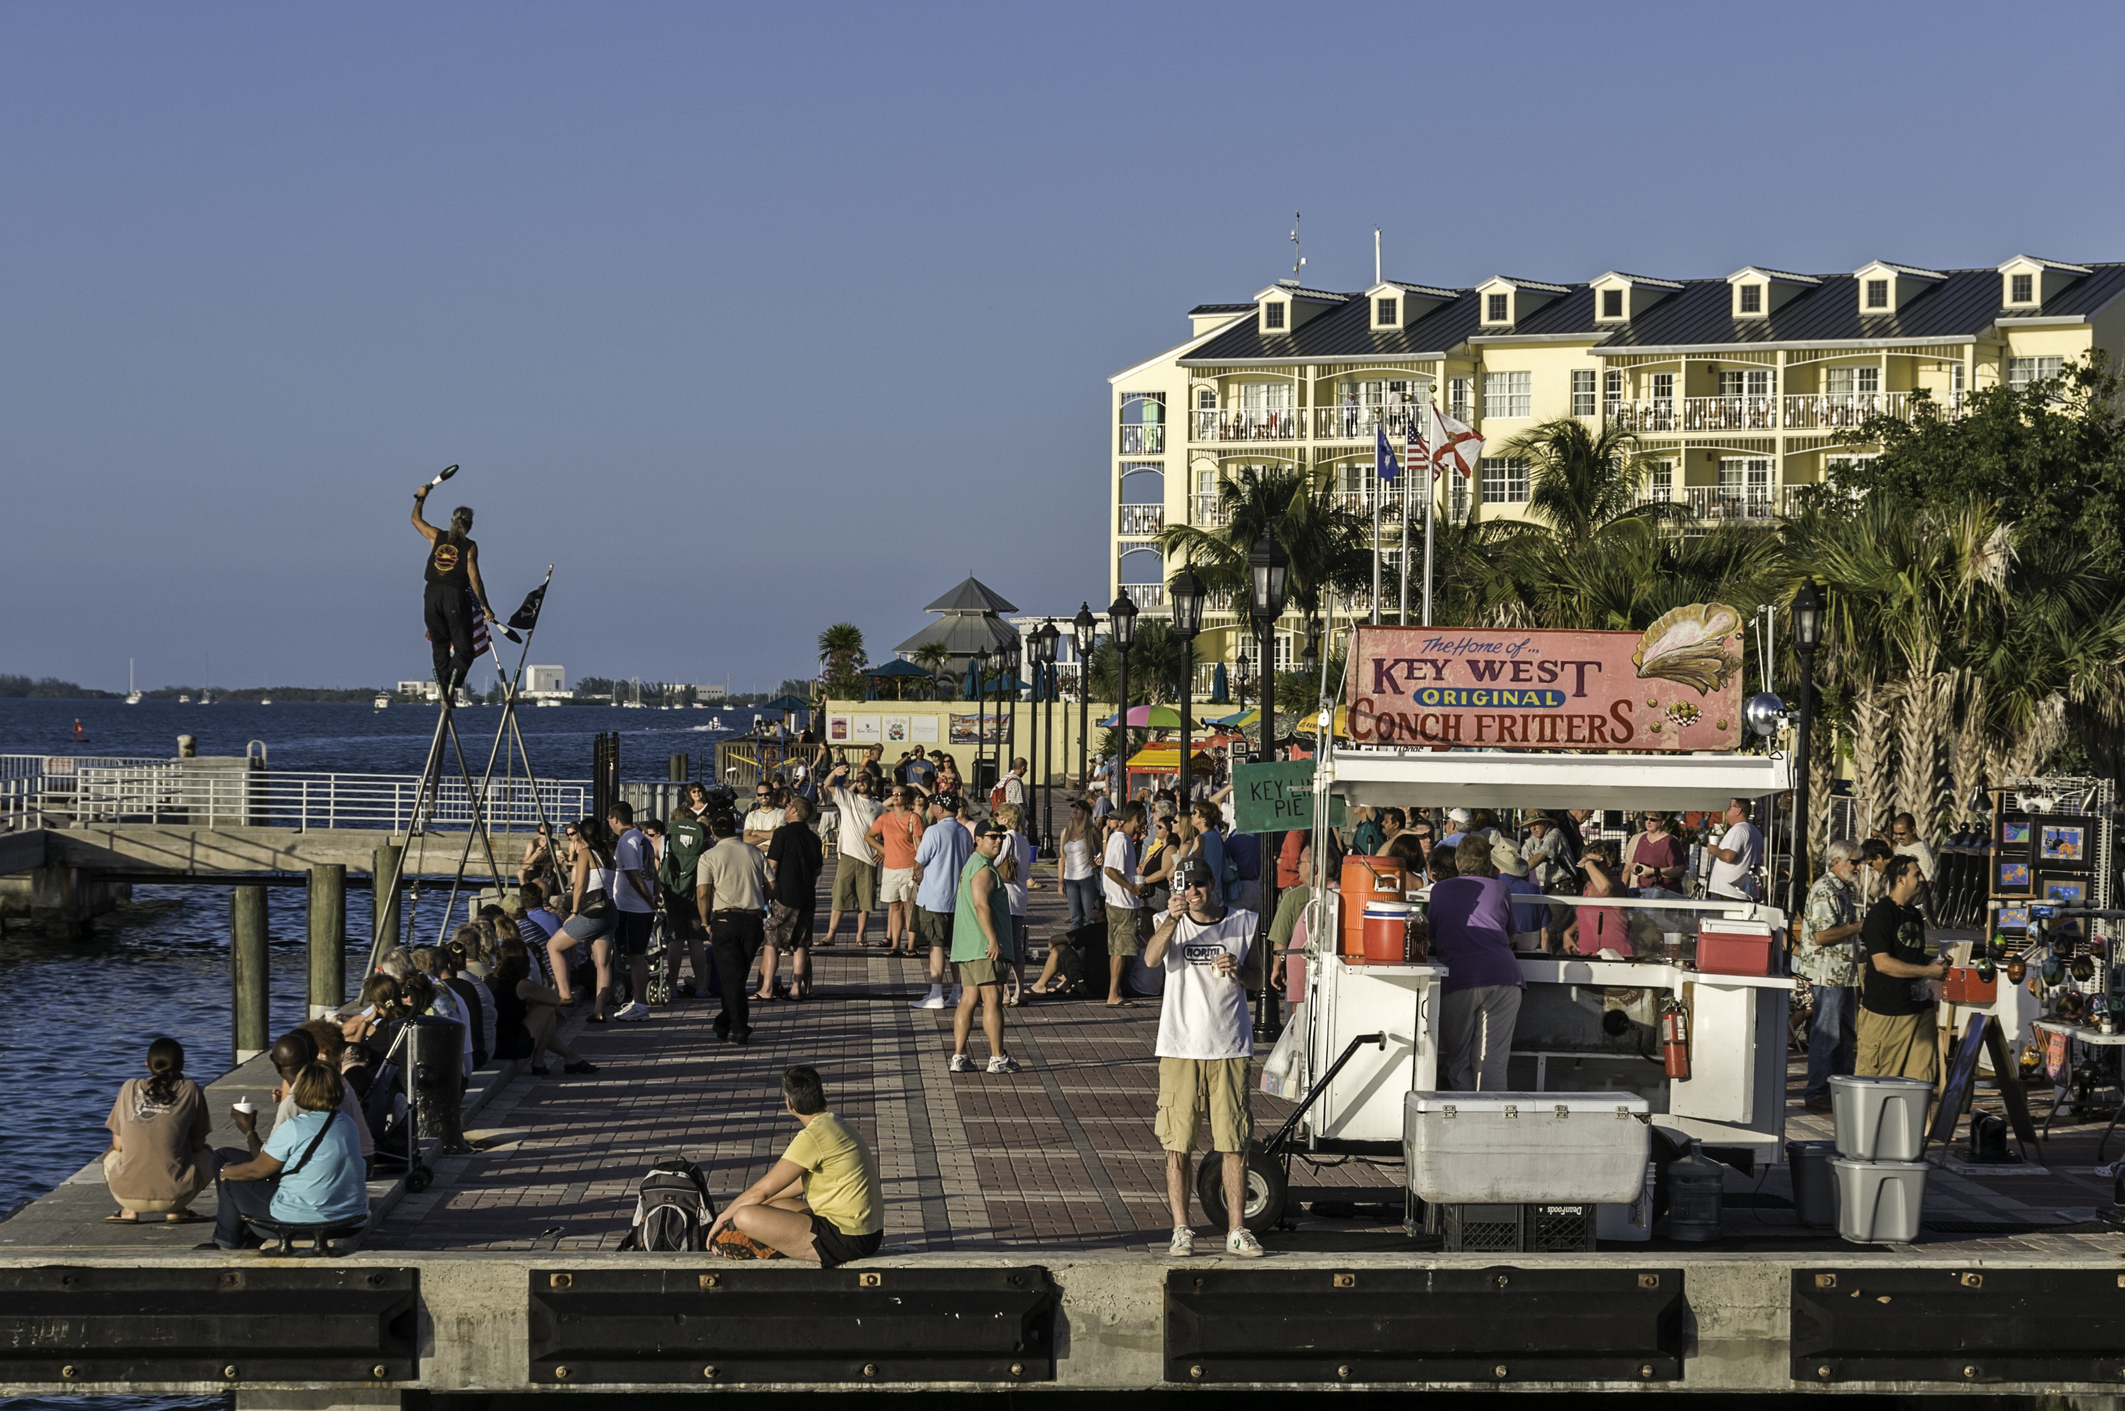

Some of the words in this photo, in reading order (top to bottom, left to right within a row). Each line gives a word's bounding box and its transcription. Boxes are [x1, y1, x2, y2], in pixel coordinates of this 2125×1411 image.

[1421, 636, 1455, 654] The
[1449, 636, 1503, 656] Home
[1371, 657, 1453, 695] KEY
[1465, 659, 1602, 698] WEST
[1422, 688, 1558, 706] ORIGINAL
[1347, 697, 1464, 742] CONCH
[1474, 698, 1635, 744] FRITTERS
[1250, 779, 1283, 801] KEY
[1275, 798, 1305, 818] PIE
